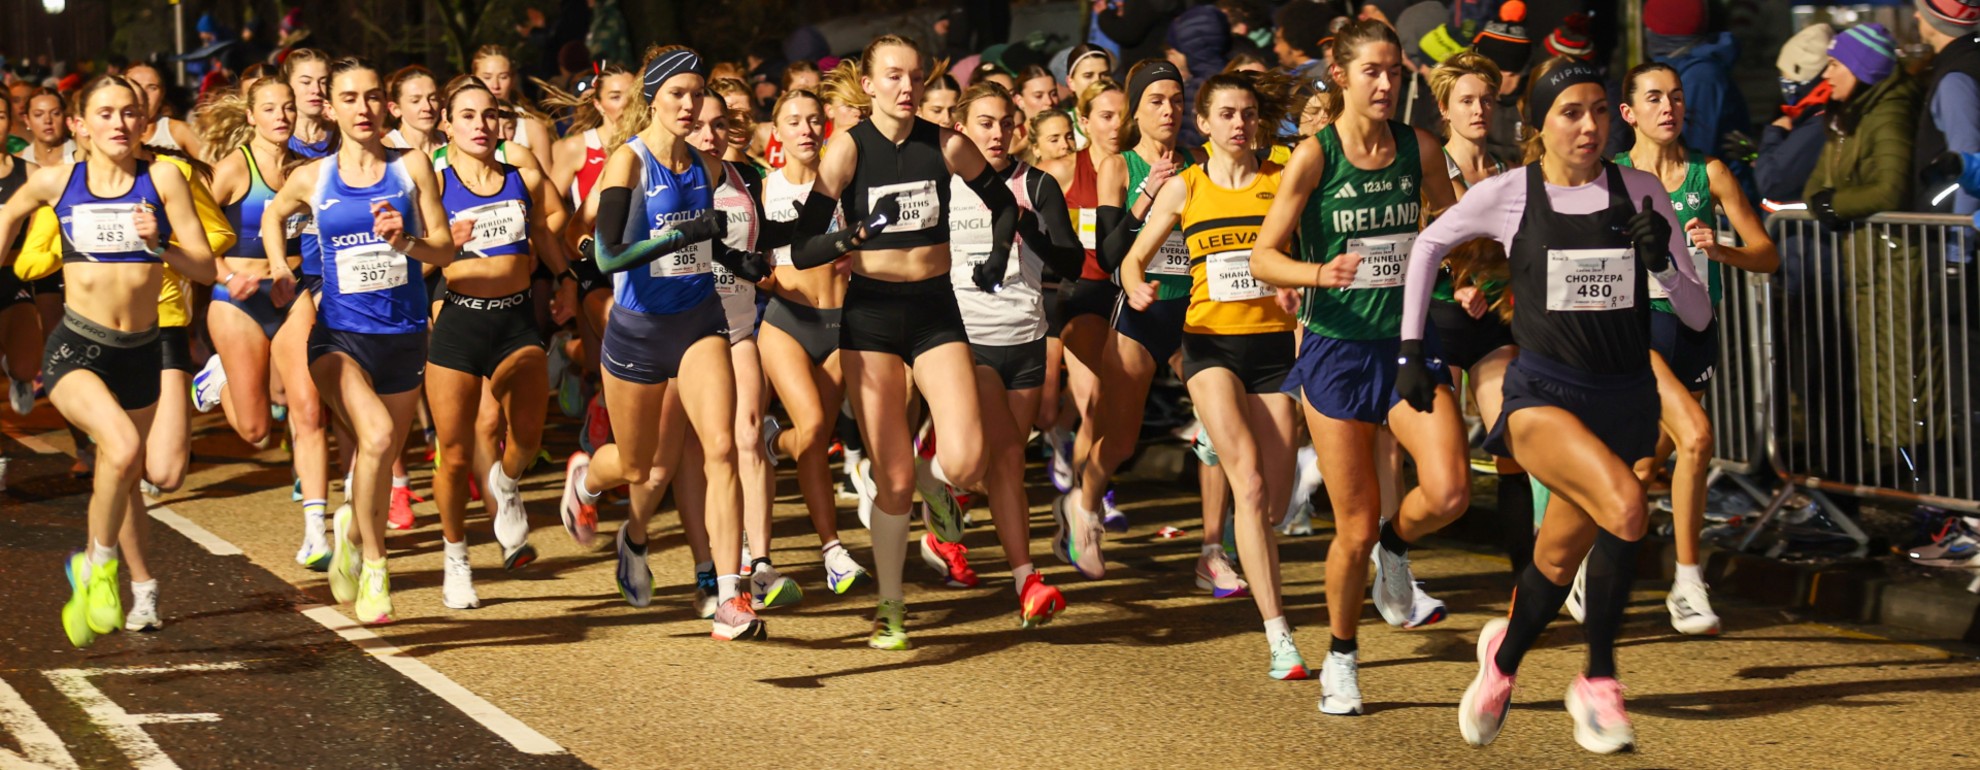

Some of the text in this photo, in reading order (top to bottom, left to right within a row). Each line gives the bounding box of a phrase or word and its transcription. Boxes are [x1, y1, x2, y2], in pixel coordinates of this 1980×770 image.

[1363, 181, 1393, 193] 123.ie
[1333, 202, 1419, 233] IRELAND
[97, 223, 124, 231] ALLEN
[483, 225, 507, 238] 478
[97, 231, 125, 242] 483
[673, 254, 697, 266] 305
[1167, 255, 1189, 266] 302
[360, 269, 387, 282] 307
[1372, 263, 1401, 276] 309
[1231, 279, 1256, 289] 481
[1565, 274, 1623, 283] CHORZEPA
[1577, 284, 1612, 297] 480
[486, 294, 524, 310] PRO
